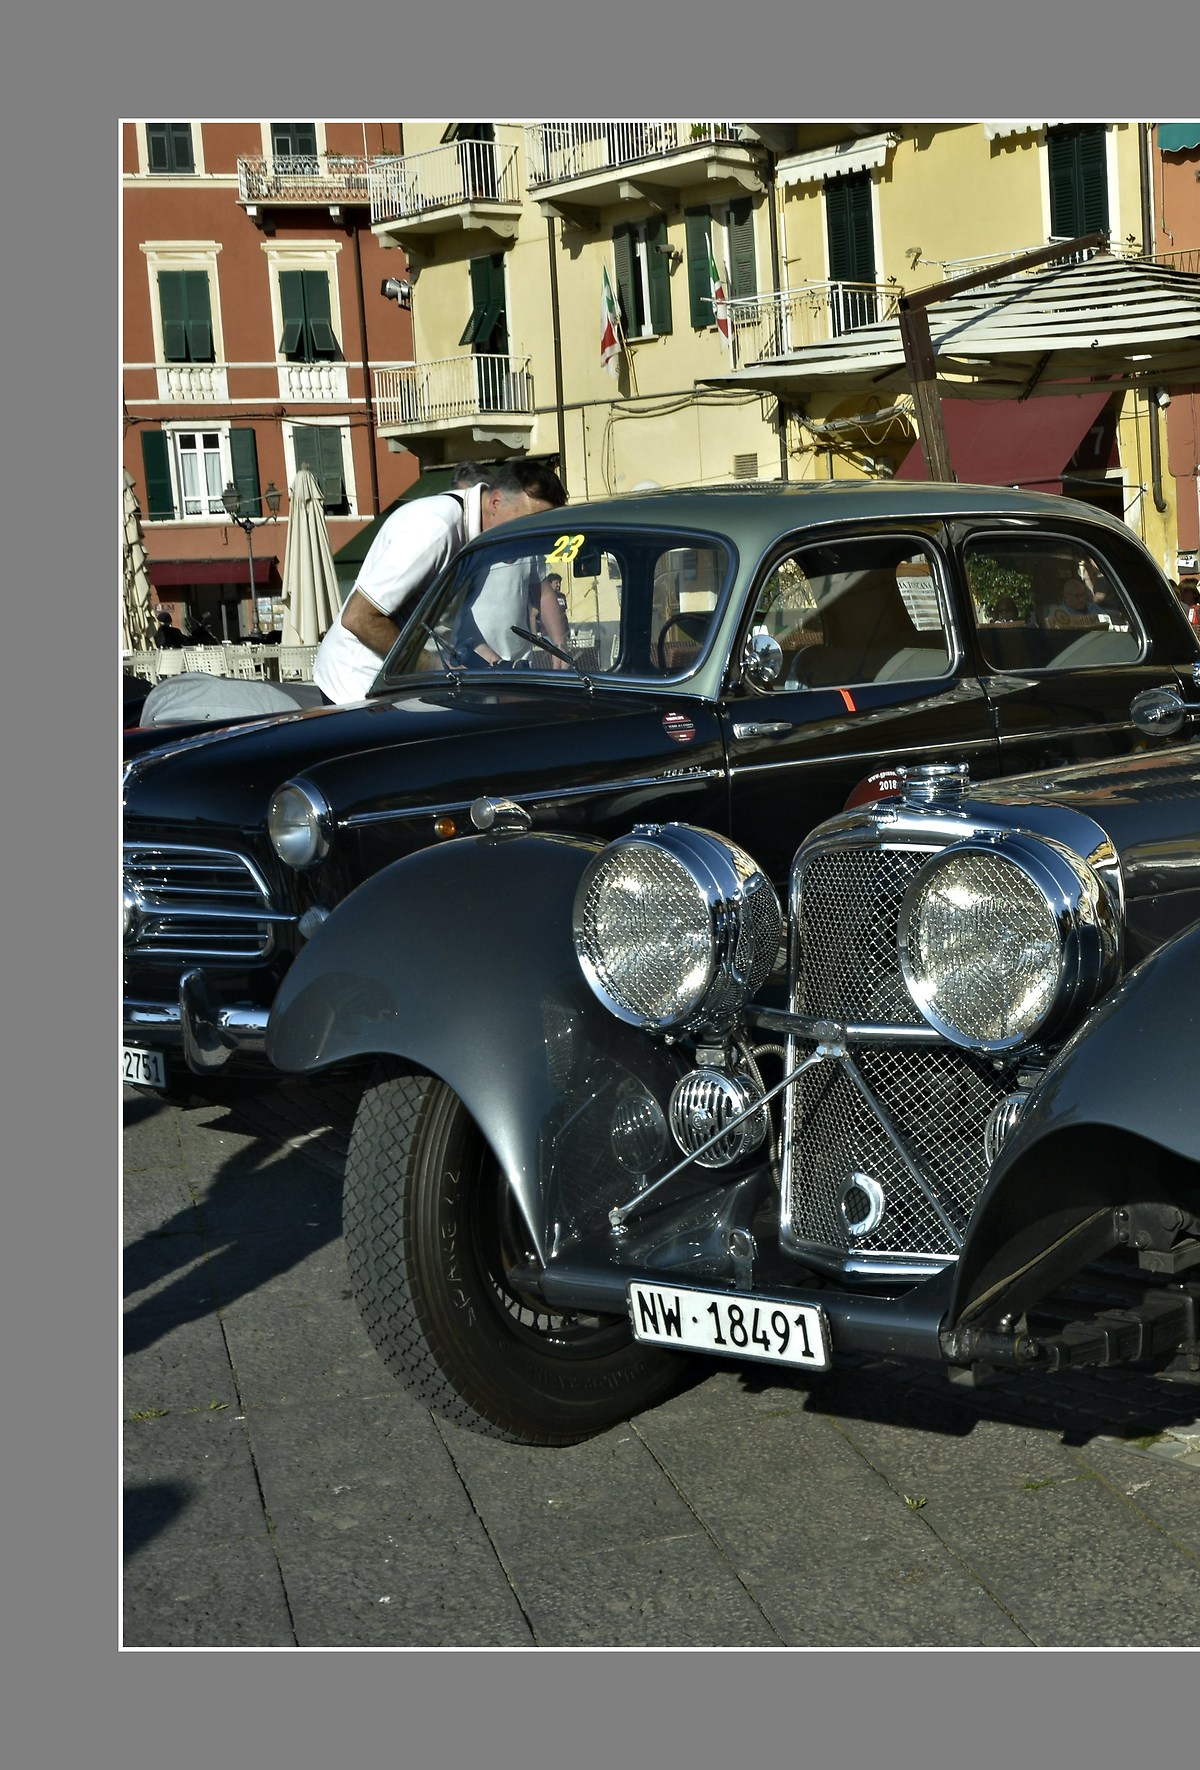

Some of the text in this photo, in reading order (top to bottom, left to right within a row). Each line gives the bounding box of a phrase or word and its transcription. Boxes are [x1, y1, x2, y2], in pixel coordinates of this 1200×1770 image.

[545, 534, 585, 563] 23
[879, 779, 898, 791] 2018
[123, 1051, 162, 1083] 2751
